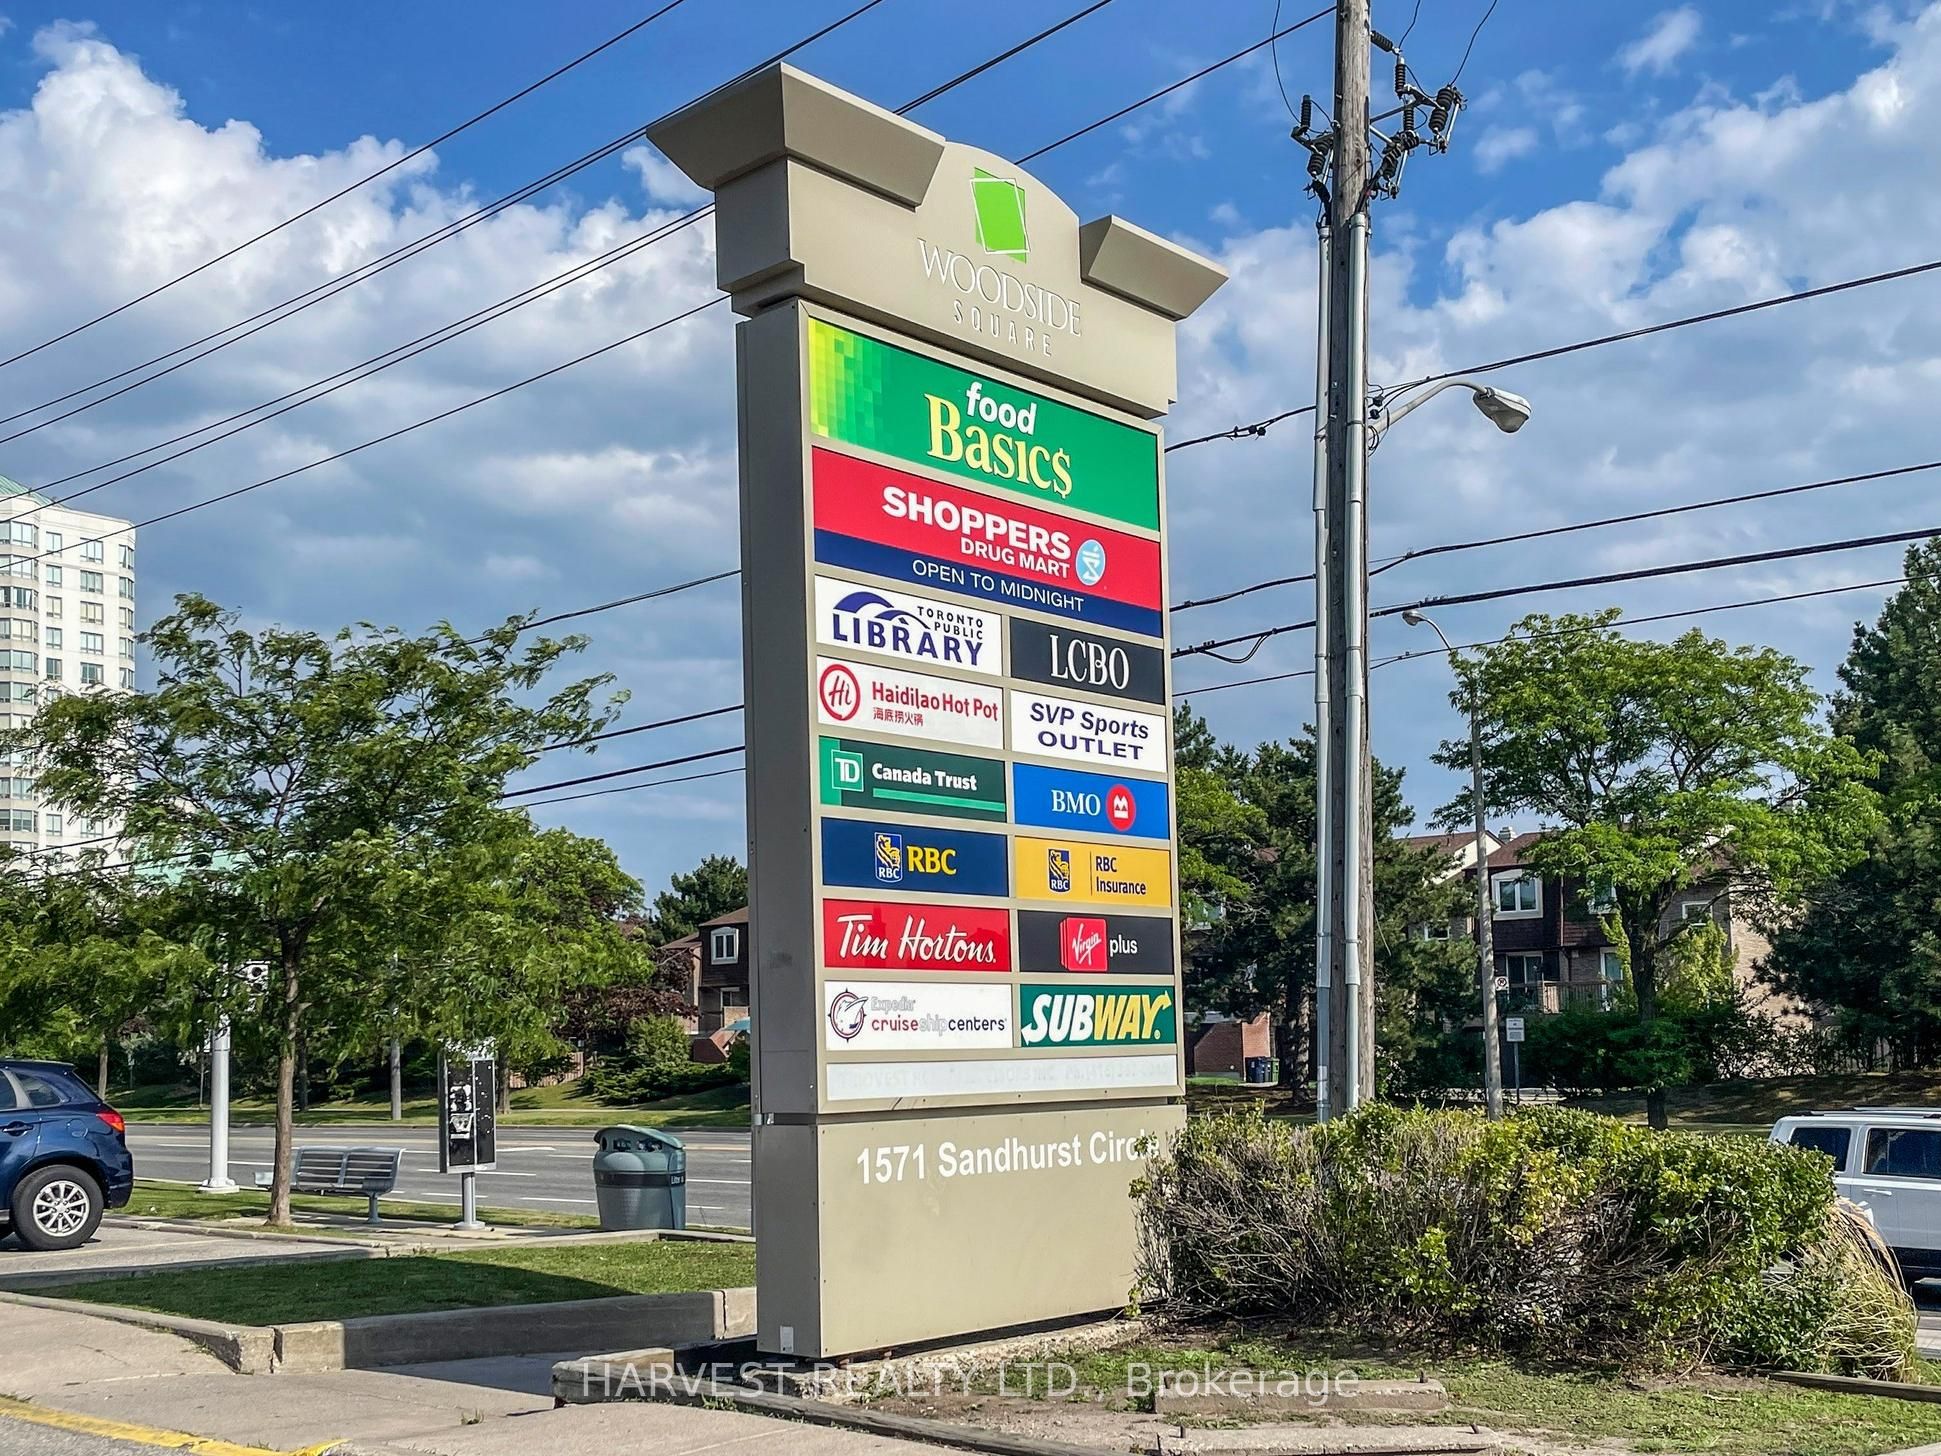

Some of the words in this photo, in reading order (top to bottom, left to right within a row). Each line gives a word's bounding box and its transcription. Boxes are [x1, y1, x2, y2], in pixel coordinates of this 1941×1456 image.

[917, 238, 1082, 337] WOODSIDE
[953, 300, 1053, 357] SQUARE
[966, 382, 1038, 436] food
[881, 486, 1072, 560] SHOPPERS
[961, 537, 1015, 567] DRUG
[1019, 555, 1070, 579] MART
[912, 559, 965, 586] OPEN
[970, 572, 995, 592] TO
[1000, 578, 1084, 613] MIDNIGHT
[917, 606, 983, 629] TORONTO
[934, 621, 983, 641] PUBLIC
[832, 613, 983, 666] LIBRARY
[1050, 634, 1129, 690] LCBO
[872, 681, 940, 710] Haidilao
[942, 693, 970, 717] Hot
[973, 698, 998, 722] Pot
[1030, 702, 1075, 726] SVP
[1080, 710, 1149, 740] Sports
[1038, 731, 1143, 760] OUTLET
[835, 757, 860, 783] TD
[872, 762, 931, 787] Canada
[934, 770, 977, 791] Trust
[1051, 789, 1101, 816] BMO
[878, 866, 900, 880] RBC
[907, 845, 957, 875] RBC
[1095, 856, 1117, 873] RBC
[1051, 879, 1068, 890] RBC
[1096, 876, 1147, 896] Insurance
[837, 914, 887, 960] Tim
[1072, 923, 1102, 966] Virgin
[1109, 934, 1138, 957] plus
[1021, 990, 1172, 1046] SUBWAY
[857, 1143, 926, 1185] 1571
[938, 1132, 1082, 1180] Sandhurst
